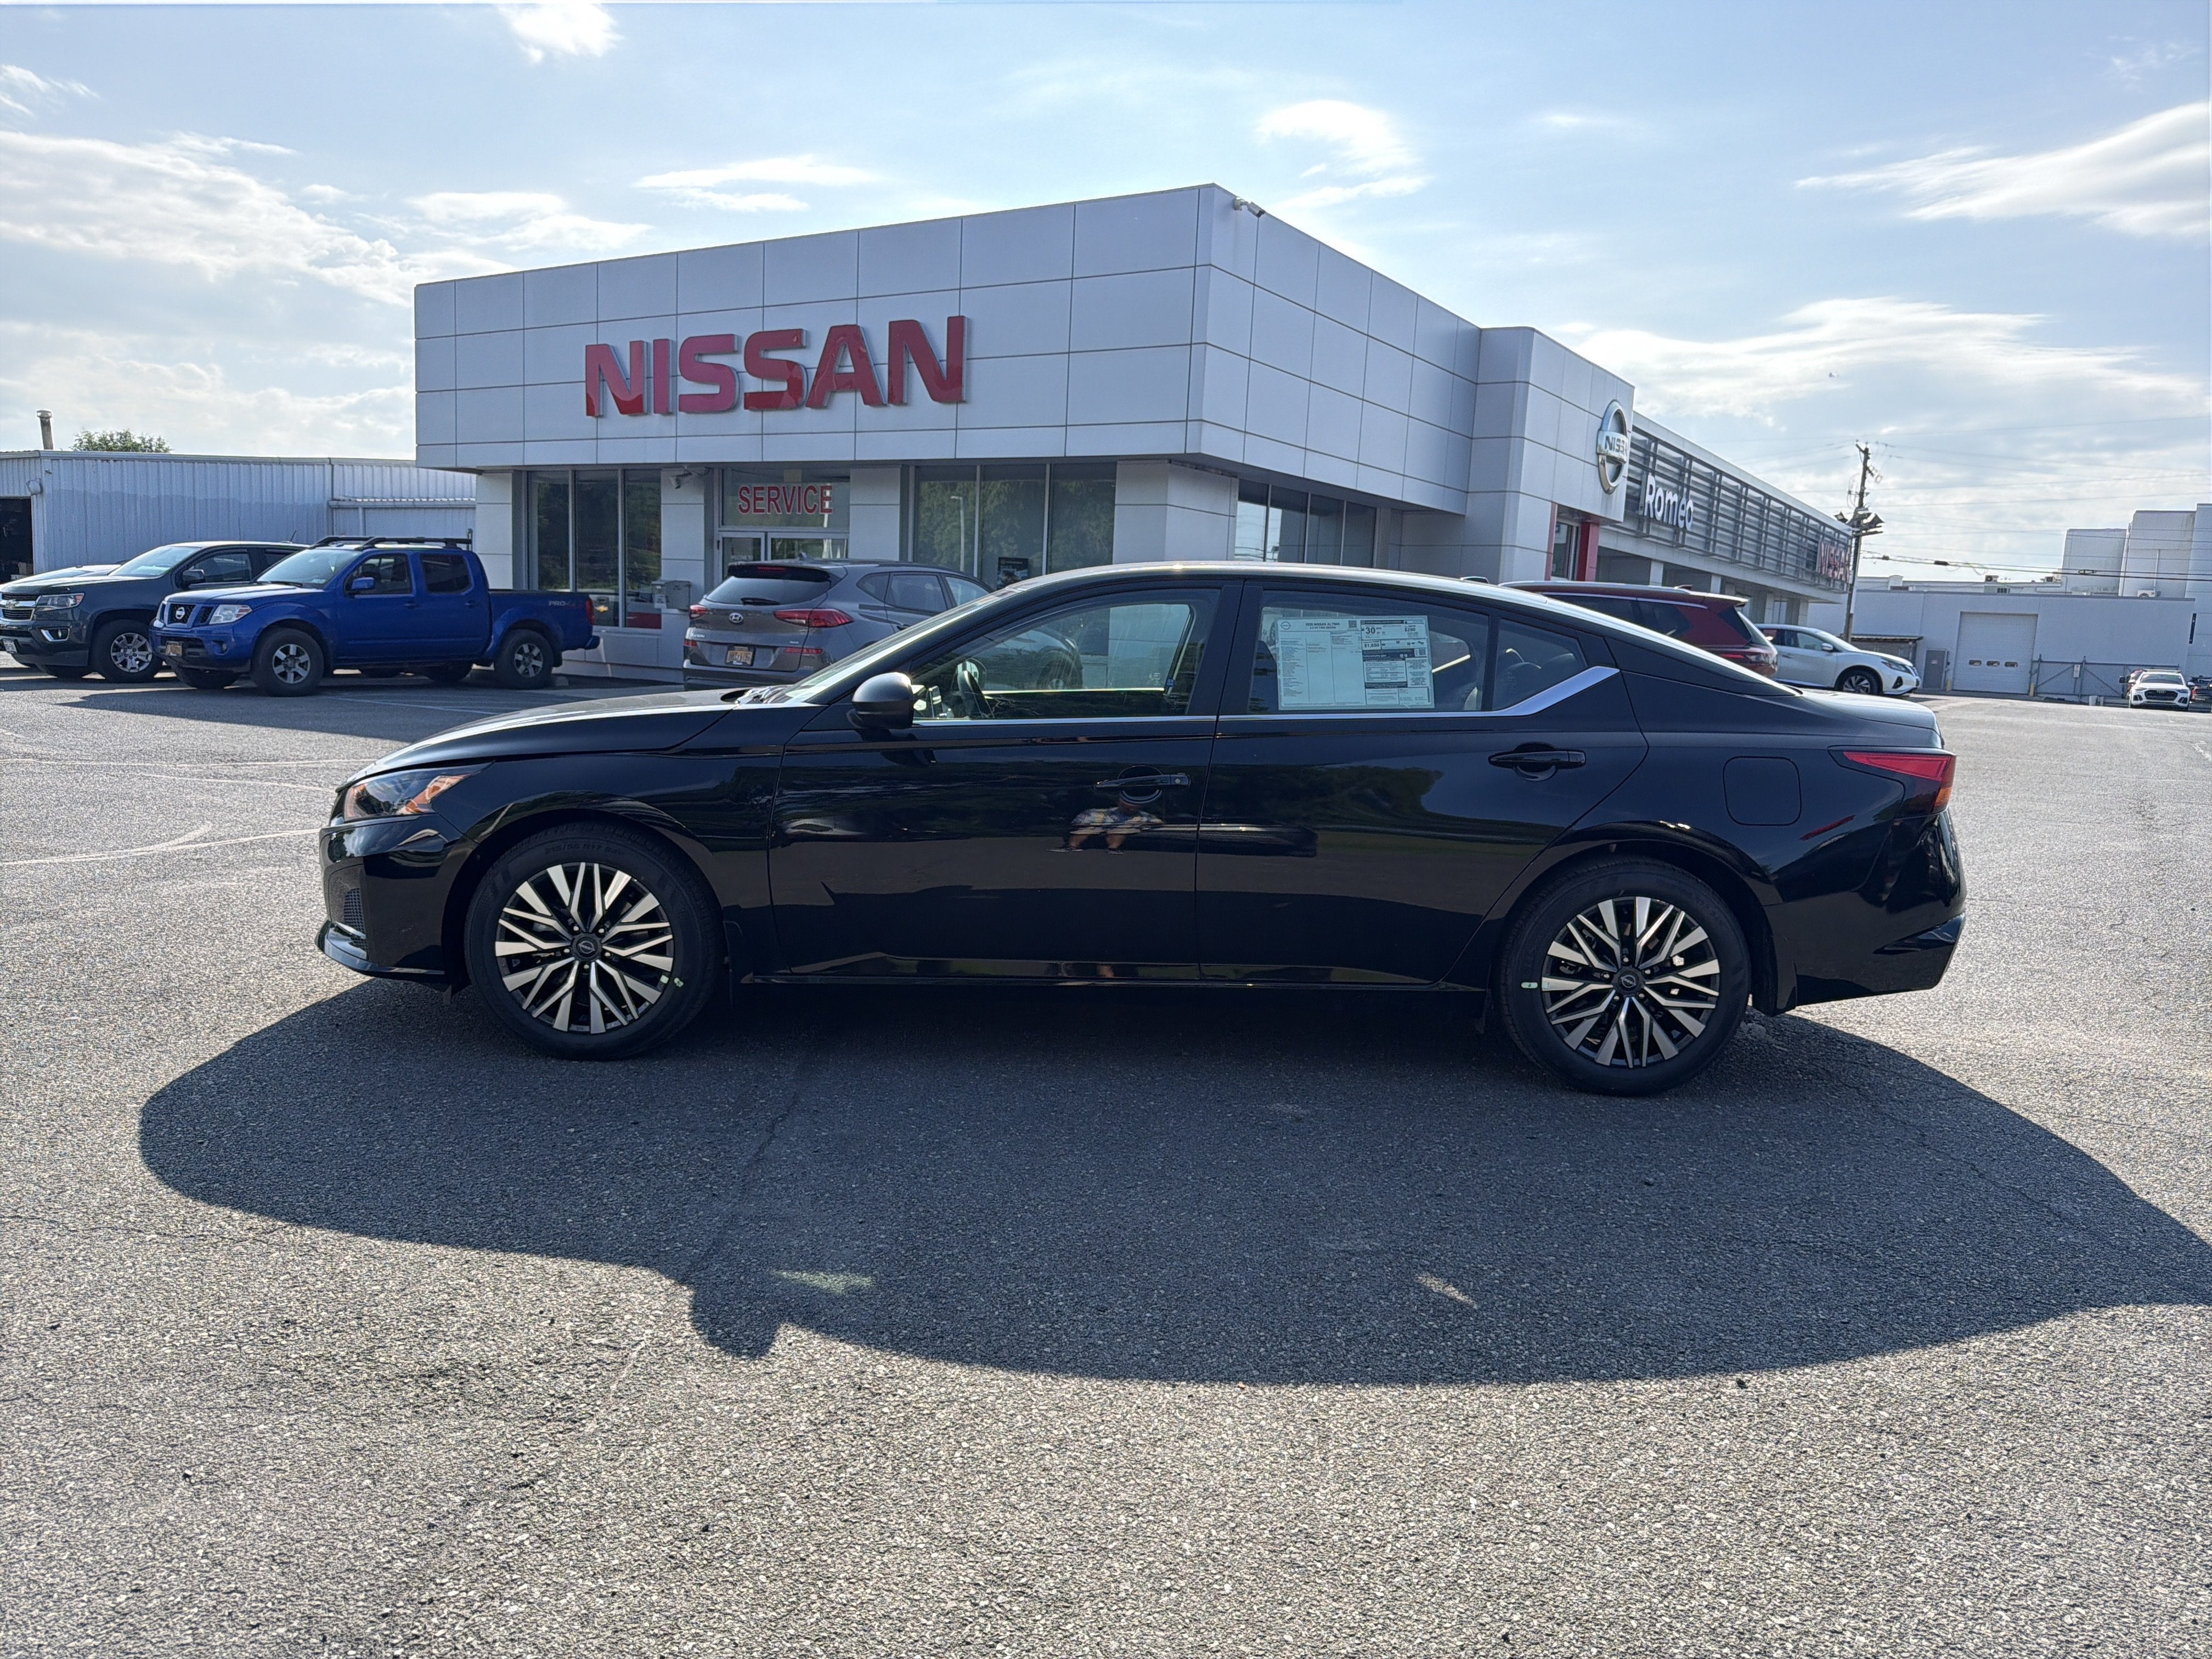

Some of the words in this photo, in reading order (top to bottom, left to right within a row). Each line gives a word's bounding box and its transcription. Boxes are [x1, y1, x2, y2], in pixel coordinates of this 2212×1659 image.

[585, 315, 967, 417] NISSAN
[1605, 435, 1627, 455] NISS
[738, 485, 833, 515] SERVICE
[1644, 475, 1694, 531] Romeo
